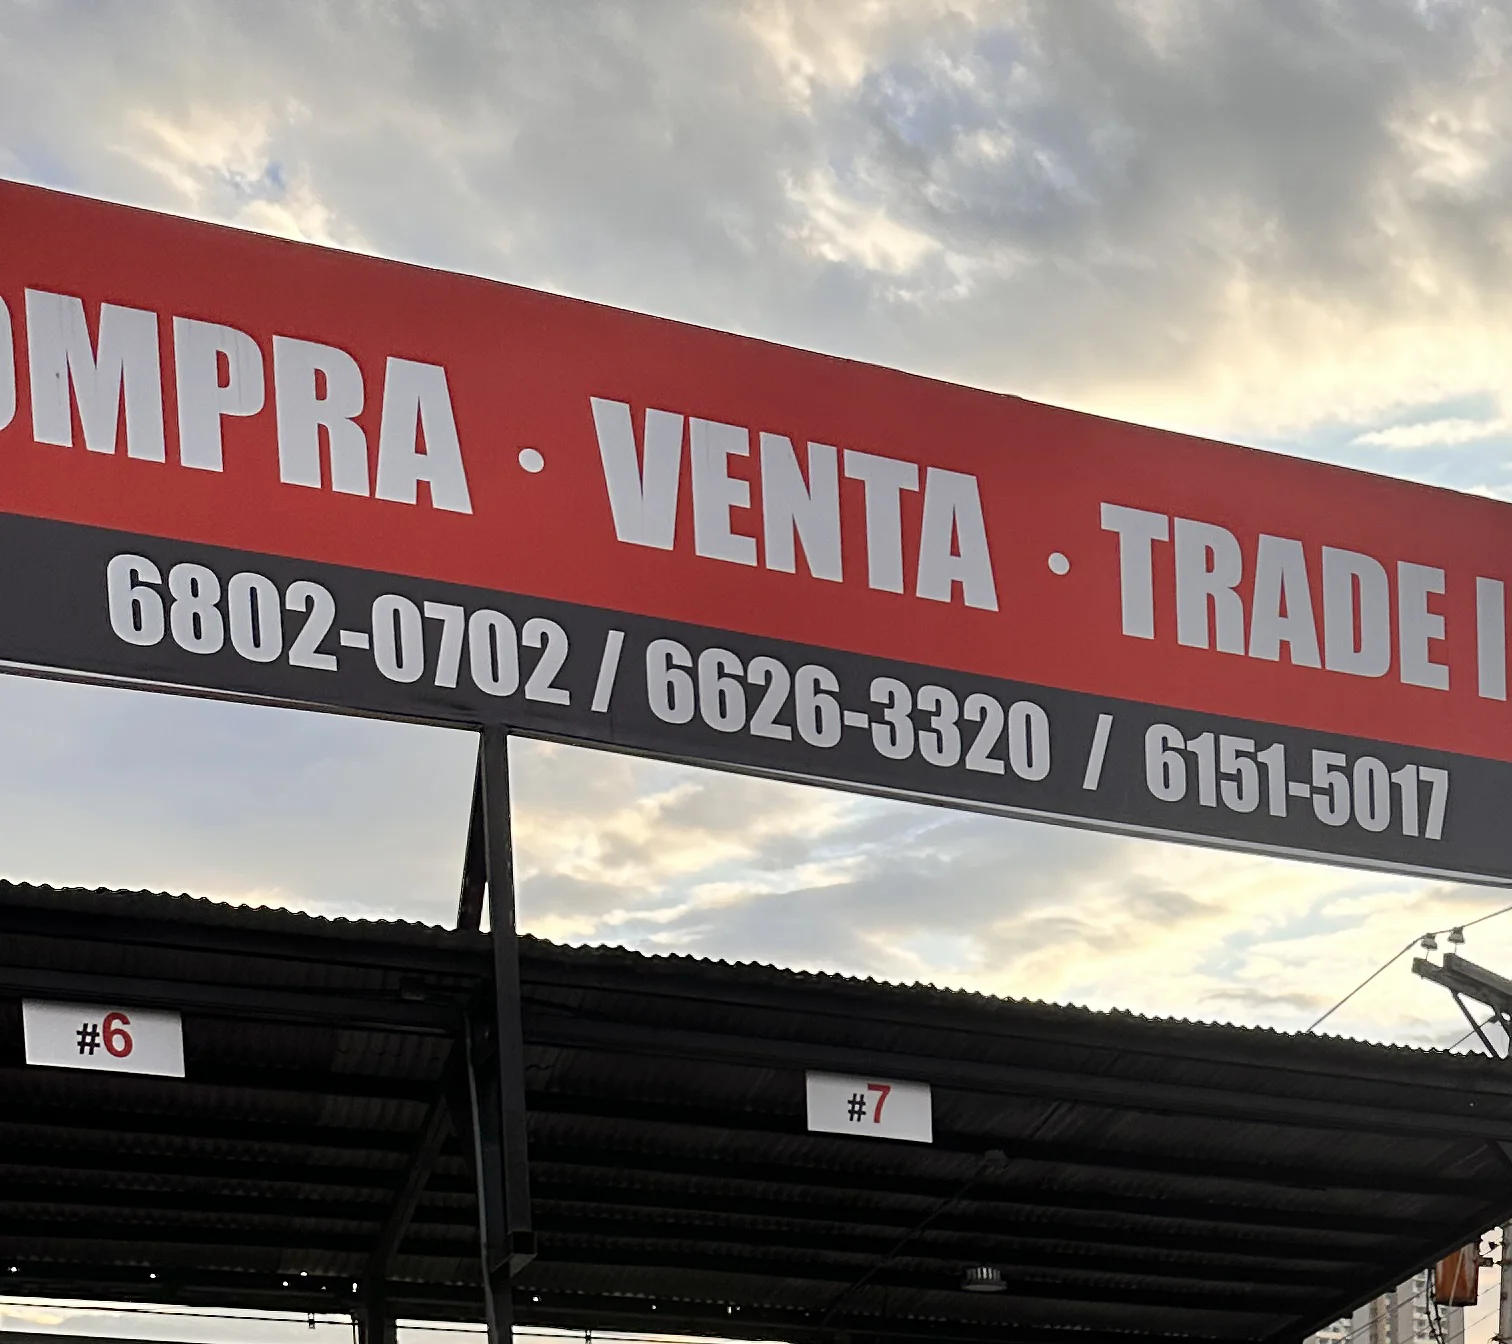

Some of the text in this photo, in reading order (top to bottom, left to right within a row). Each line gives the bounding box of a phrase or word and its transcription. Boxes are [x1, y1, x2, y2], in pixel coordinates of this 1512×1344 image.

[0, 286, 474, 516] MPRA
[589, 396, 999, 612] VENTA
[1100, 502, 1450, 691] TRADE
[106, 553, 571, 706] 6802-0702
[645, 638, 1051, 782] 6626-3320
[1144, 723, 1449, 841] 6151-5017
[76, 1011, 133, 1058] #6
[847, 1082, 892, 1123] #7
